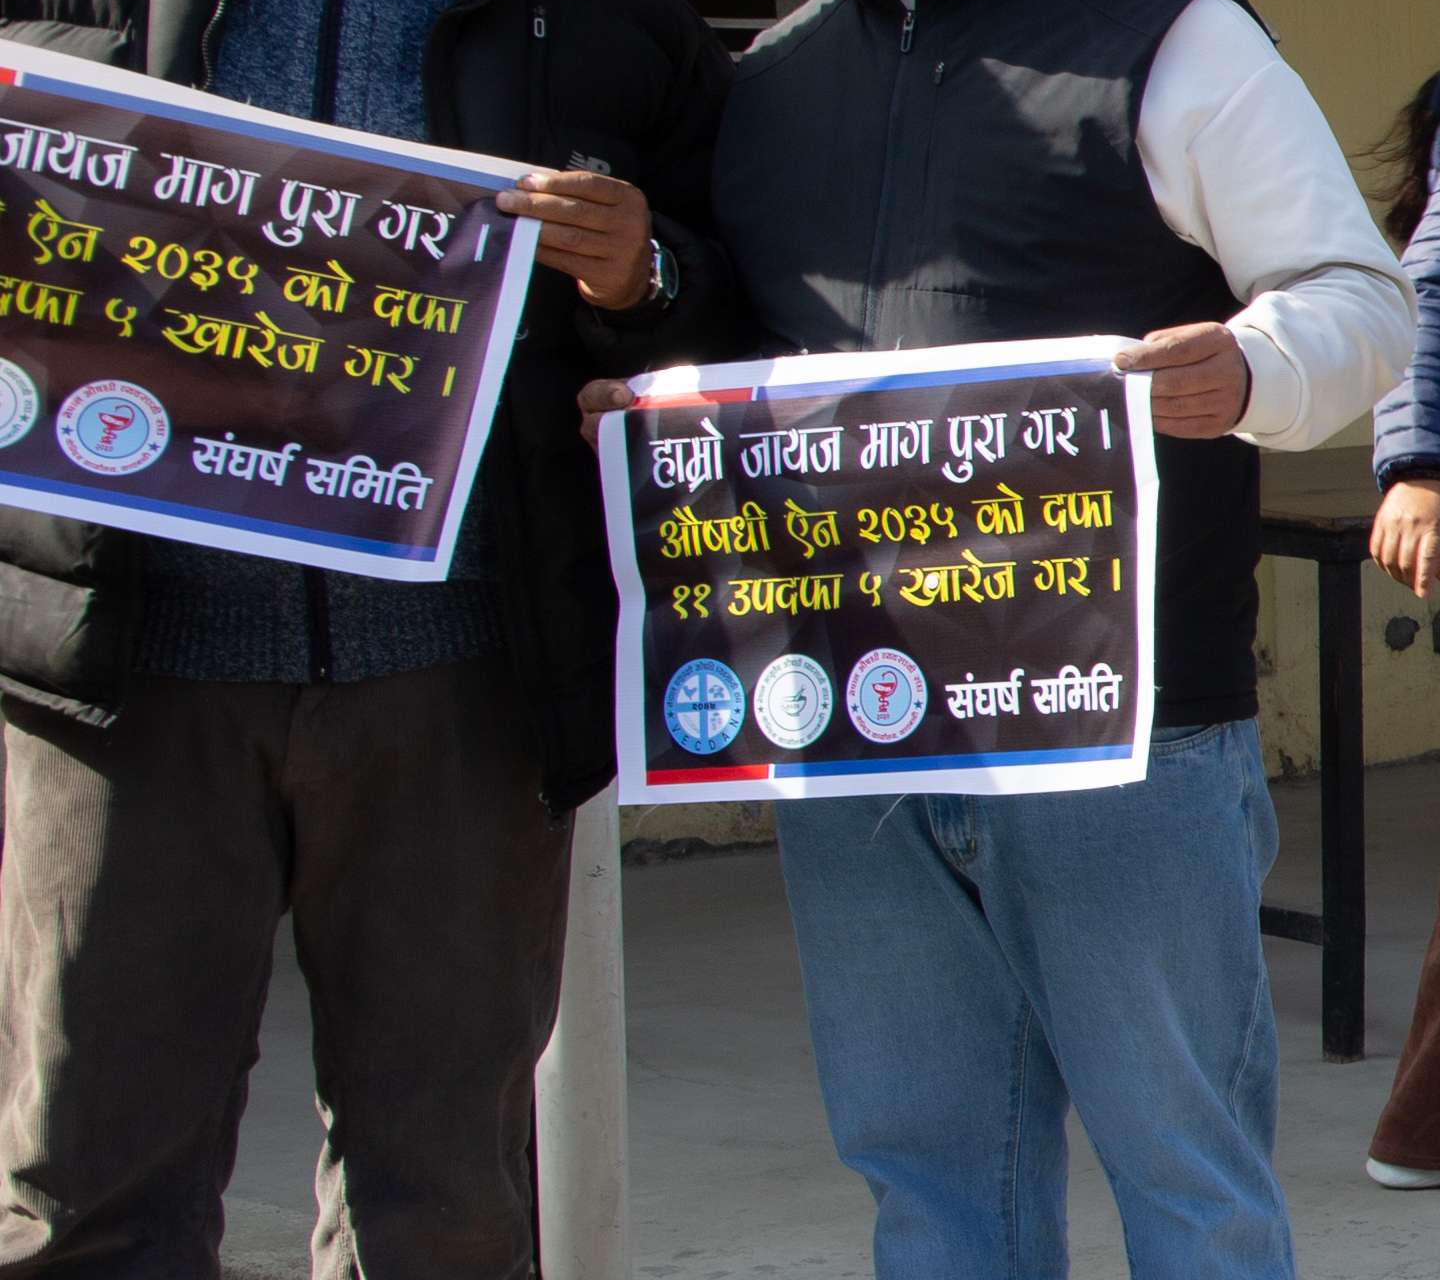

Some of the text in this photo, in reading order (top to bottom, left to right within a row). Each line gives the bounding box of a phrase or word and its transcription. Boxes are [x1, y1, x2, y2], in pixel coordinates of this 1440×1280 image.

[154, 152, 262, 216] माग
[262, 178, 363, 247] पुरा
[378, 199, 456, 260] गर
[27, 198, 465, 333] ऐन २०३५ को दफा
[162, 308, 326, 373] खारेज
[344, 347, 414, 393] गर
[192, 432, 434, 510] संघर्ष समिति
[648, 416, 724, 493] हाम्रो
[739, 425, 845, 478] जायज
[859, 418, 935, 470] माग
[941, 412, 1008, 484] पुरा
[1020, 406, 1080, 457] गर
[659, 482, 1113, 559] औषधी ऐन २०३५ को दफा
[672, 583, 711, 619] ११
[727, 573, 842, 617] उपदफा
[899, 548, 1016, 608] खारेज
[1031, 556, 1092, 597] गर
[944, 667, 1025, 719] संघर्ष
[1030, 662, 1124, 715] समिति
